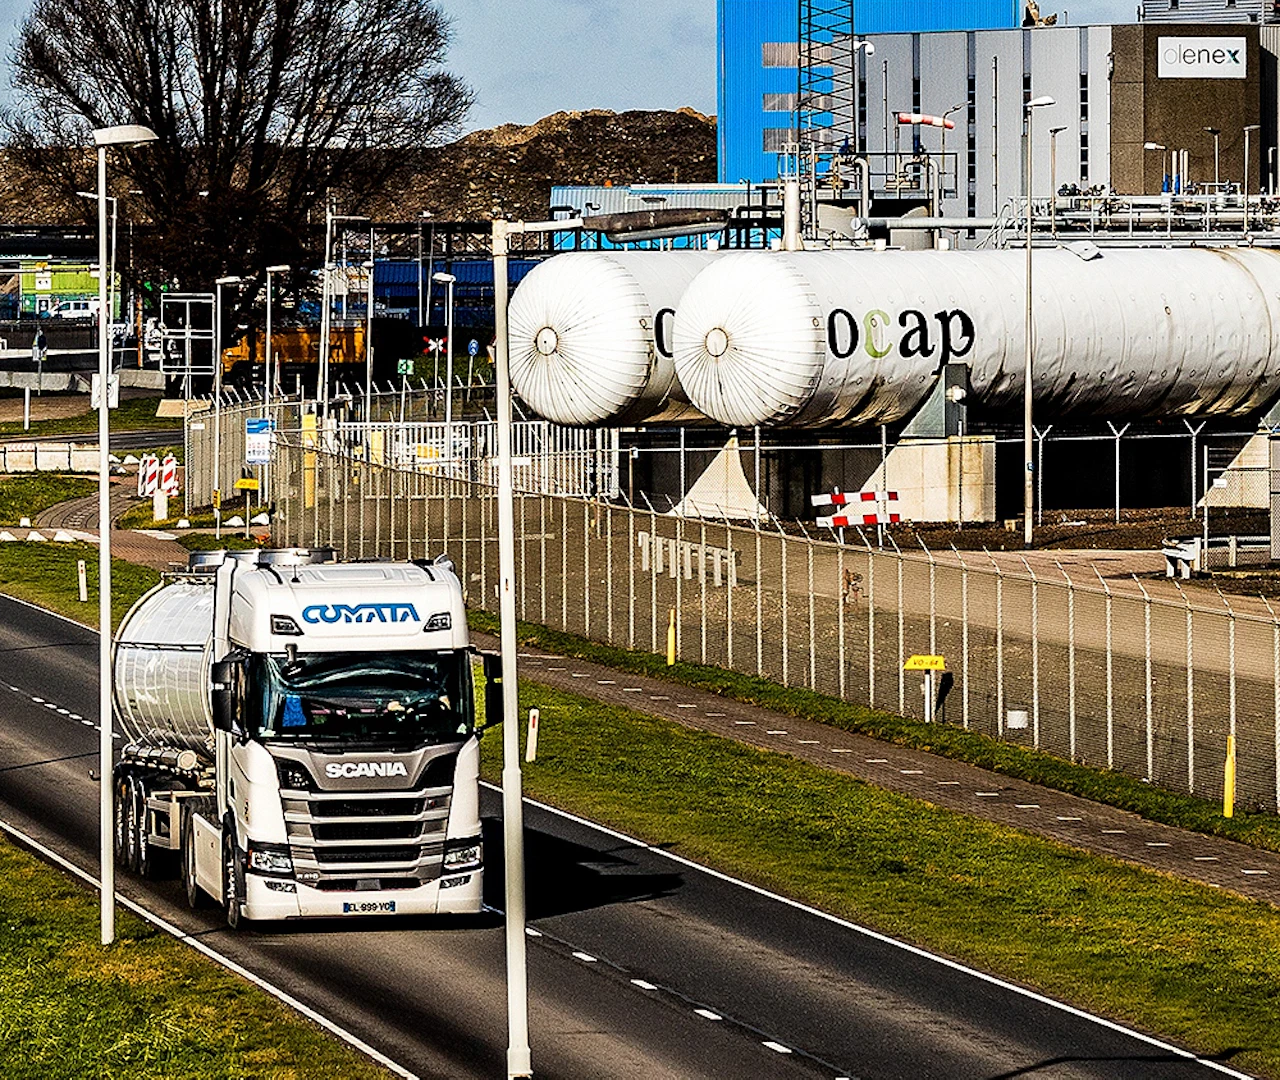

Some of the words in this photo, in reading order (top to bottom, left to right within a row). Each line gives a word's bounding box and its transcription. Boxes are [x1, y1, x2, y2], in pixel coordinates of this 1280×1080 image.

[1164, 44, 1240, 65] olenex
[828, 308, 975, 377] ocap
[325, 761, 408, 779] SCANIA
